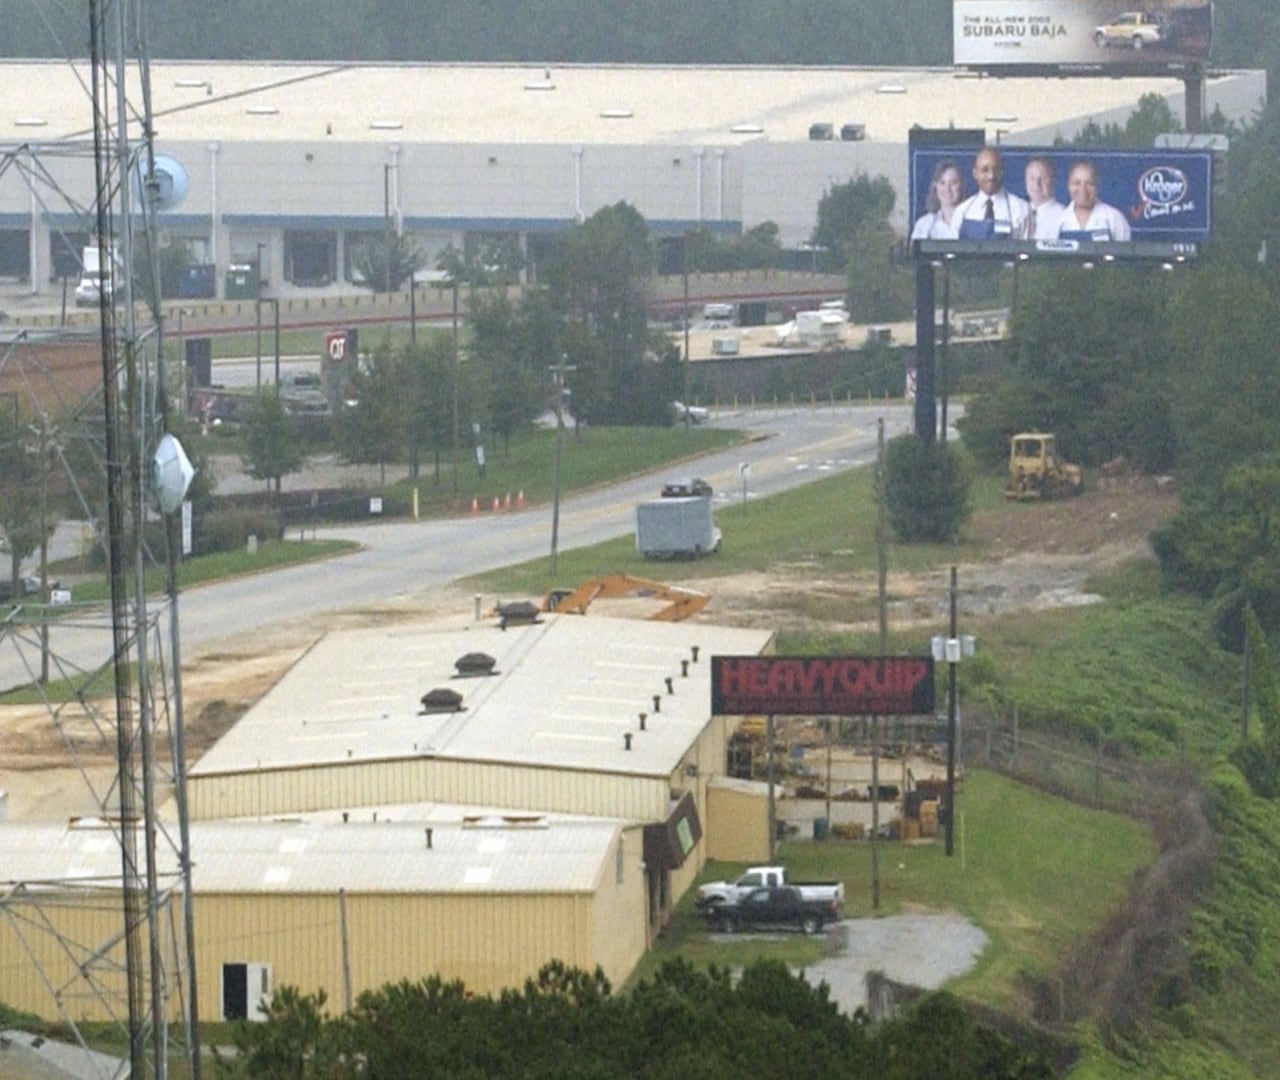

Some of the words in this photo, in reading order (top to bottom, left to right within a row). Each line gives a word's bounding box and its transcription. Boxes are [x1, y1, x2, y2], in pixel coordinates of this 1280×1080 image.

[963, 25, 1026, 37] SUBARU
[1030, 25, 1067, 38] BAJA
[1144, 171, 1183, 201] Kroger
